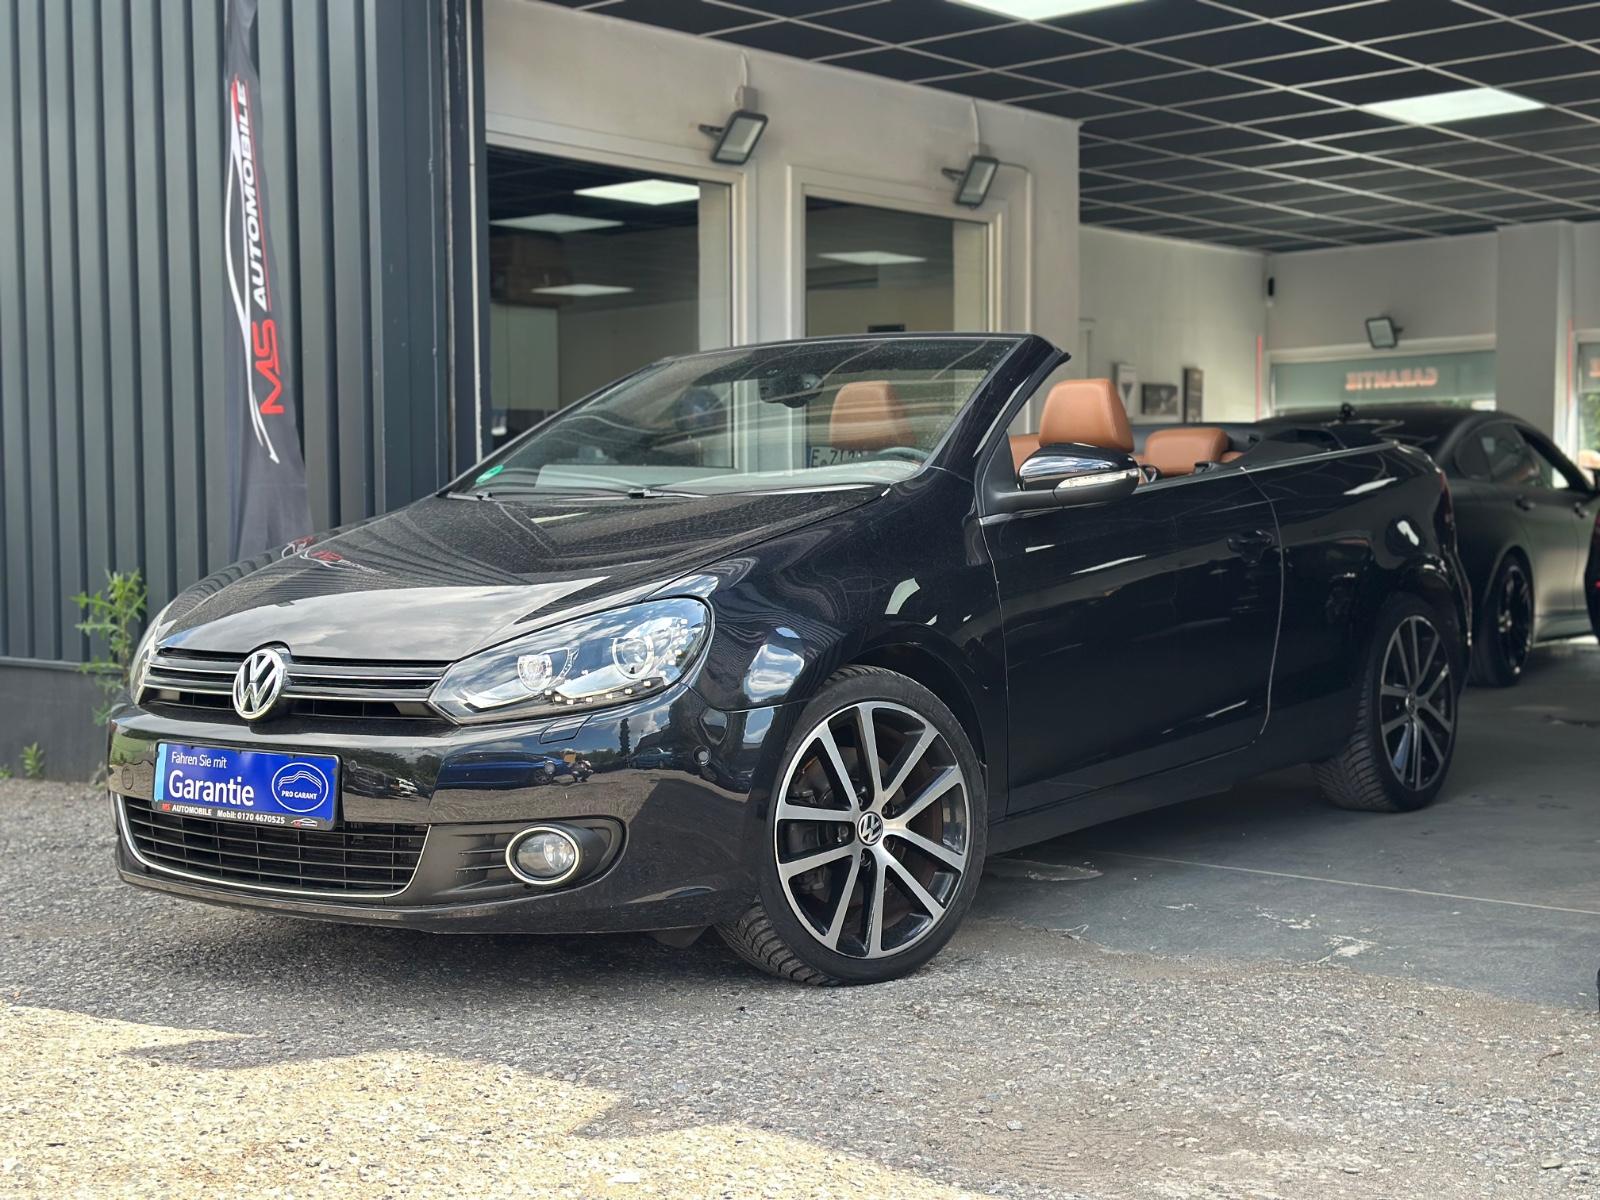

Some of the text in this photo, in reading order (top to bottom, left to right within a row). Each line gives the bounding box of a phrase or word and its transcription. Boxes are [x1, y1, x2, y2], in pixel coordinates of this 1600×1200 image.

[236, 79, 285, 414] MS AUTOMOBILE
[171, 751, 227, 769] Fahren Sie mit
[168, 770, 254, 806] Garantie
[281, 790, 318, 800] PRO GARANT
[172, 804, 212, 817] AUTOMOBILE
[217, 809, 237, 819] Mobil:
[237, 811, 254, 821] 0170
[254, 813, 286, 825] 4670525
